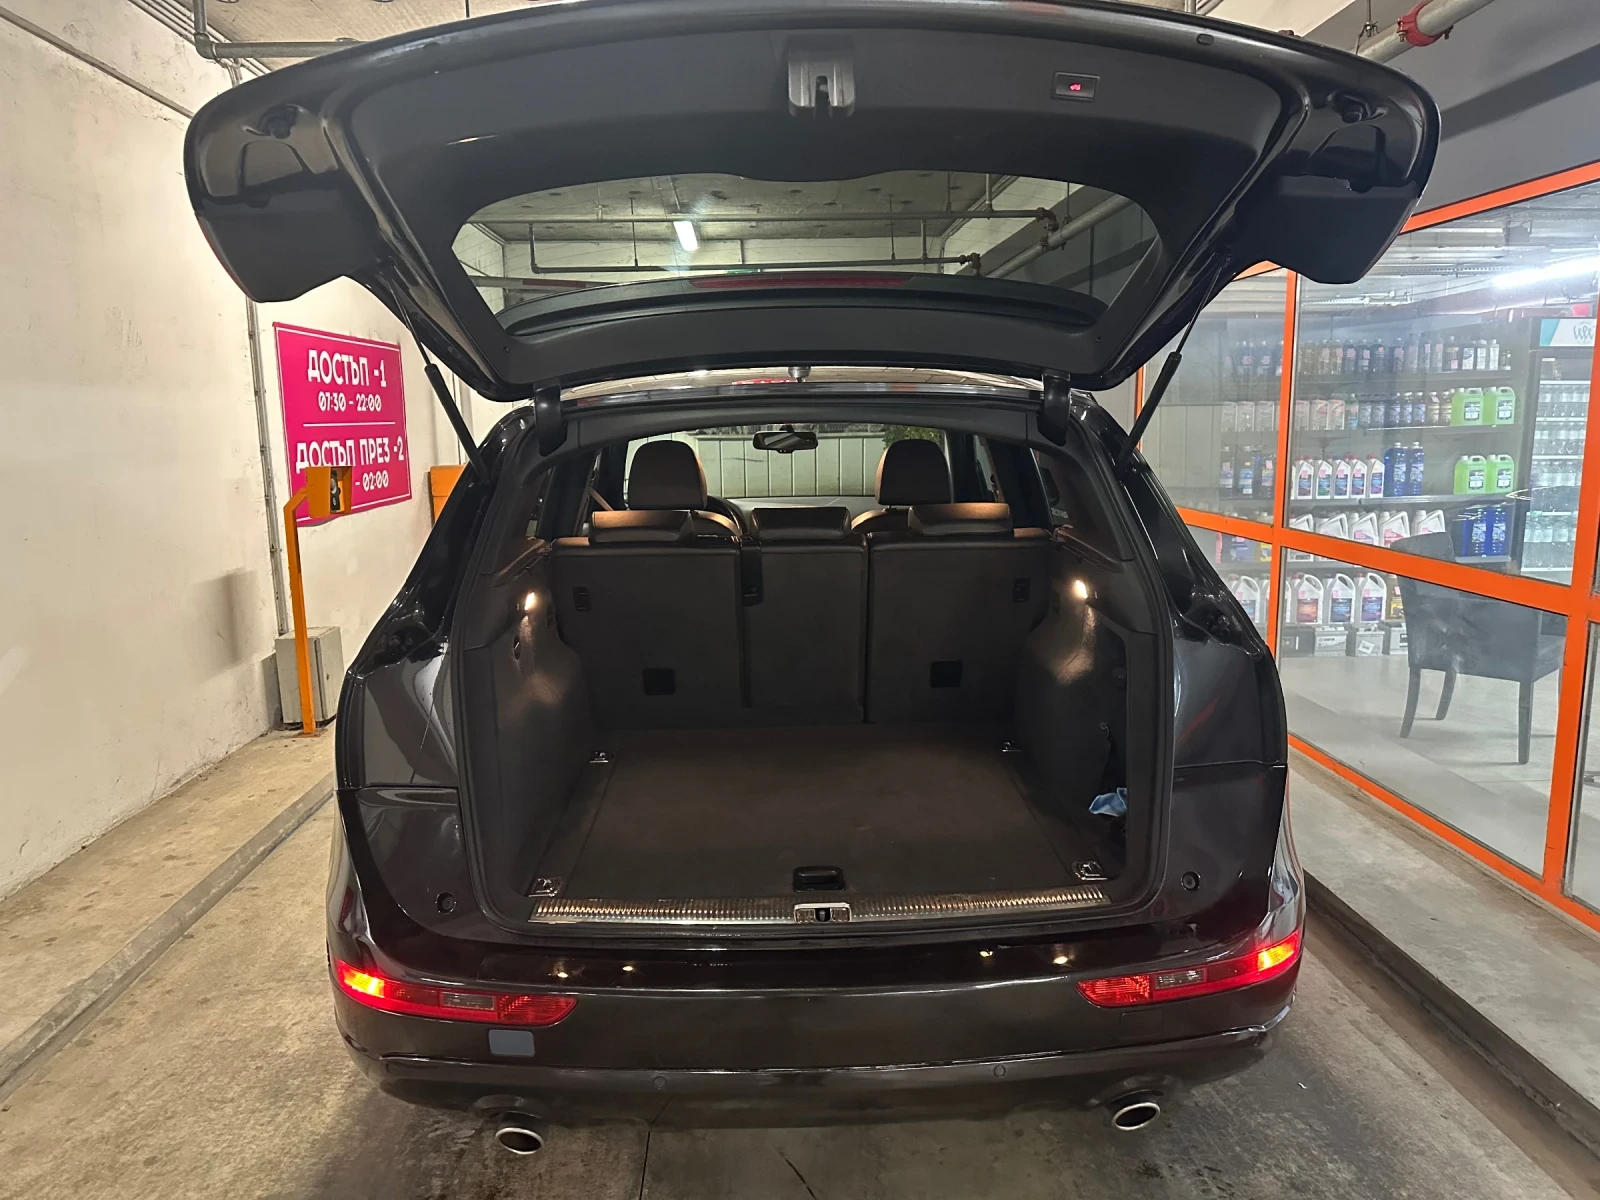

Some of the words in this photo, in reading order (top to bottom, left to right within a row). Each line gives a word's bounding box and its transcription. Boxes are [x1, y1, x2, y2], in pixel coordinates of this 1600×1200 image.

[308, 349, 369, 386] ДОСТЪП
[373, 359, 387, 388] -1
[318, 391, 346, 412] 07:30
[356, 393, 382, 412] 22:00
[295, 440, 356, 474] ДОСТЪП
[359, 437, 390, 466] ПРЕЗ
[393, 436, 404, 461] -2
[362, 469, 389, 492] 02:00
